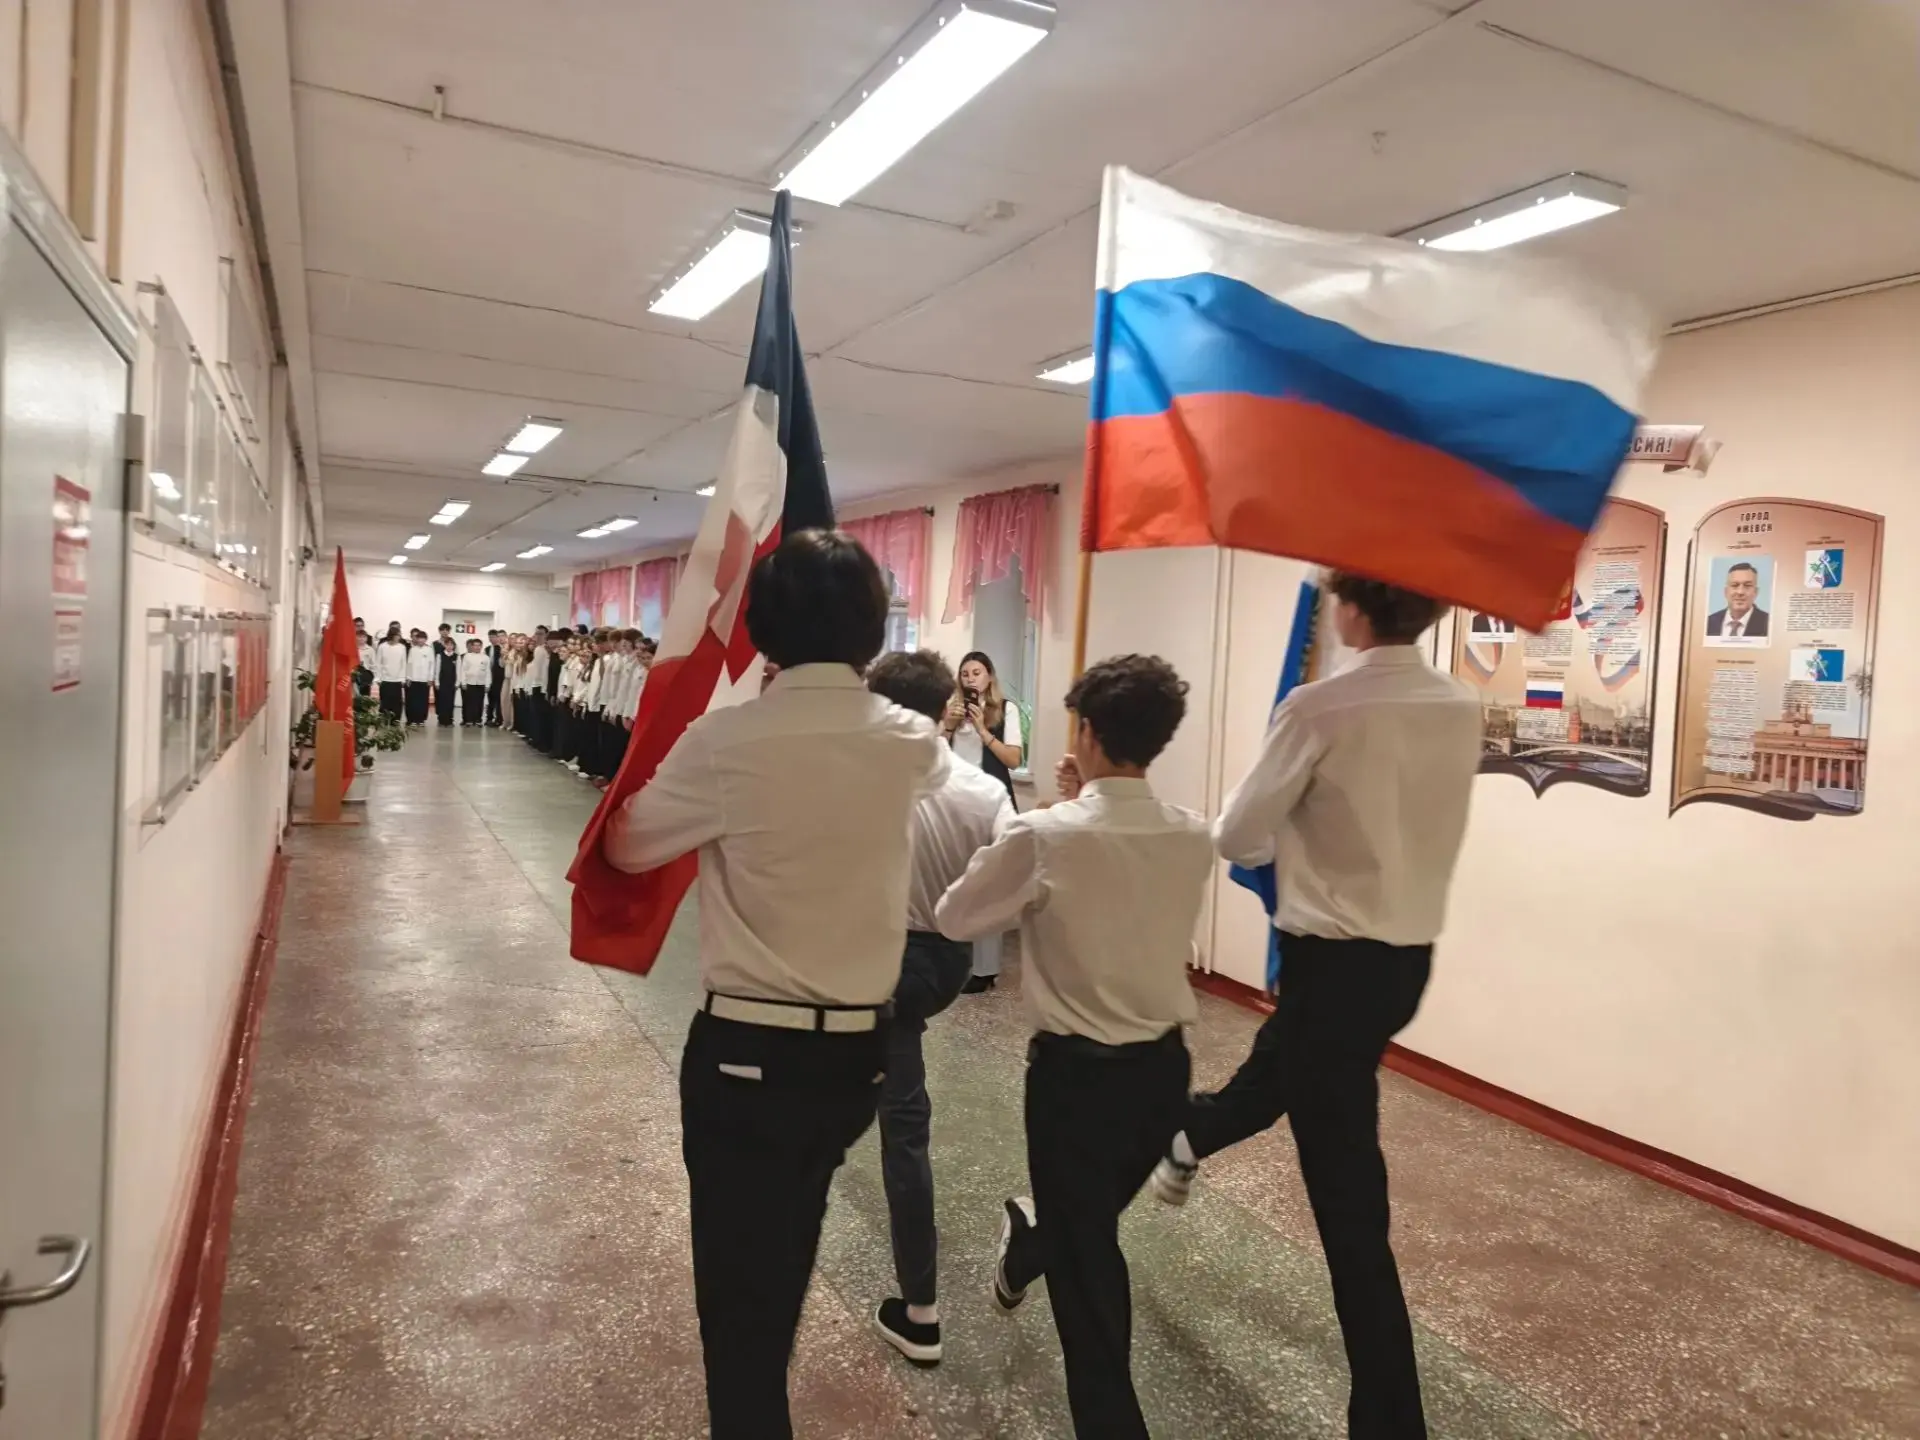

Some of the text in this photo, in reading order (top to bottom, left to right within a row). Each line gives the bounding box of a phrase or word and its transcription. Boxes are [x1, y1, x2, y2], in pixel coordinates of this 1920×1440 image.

[1626, 436, 1673, 453] СИЯ!
[1740, 511, 1770, 522] ГОРОД
[1736, 523, 1773, 533] ИЖЕВСК
